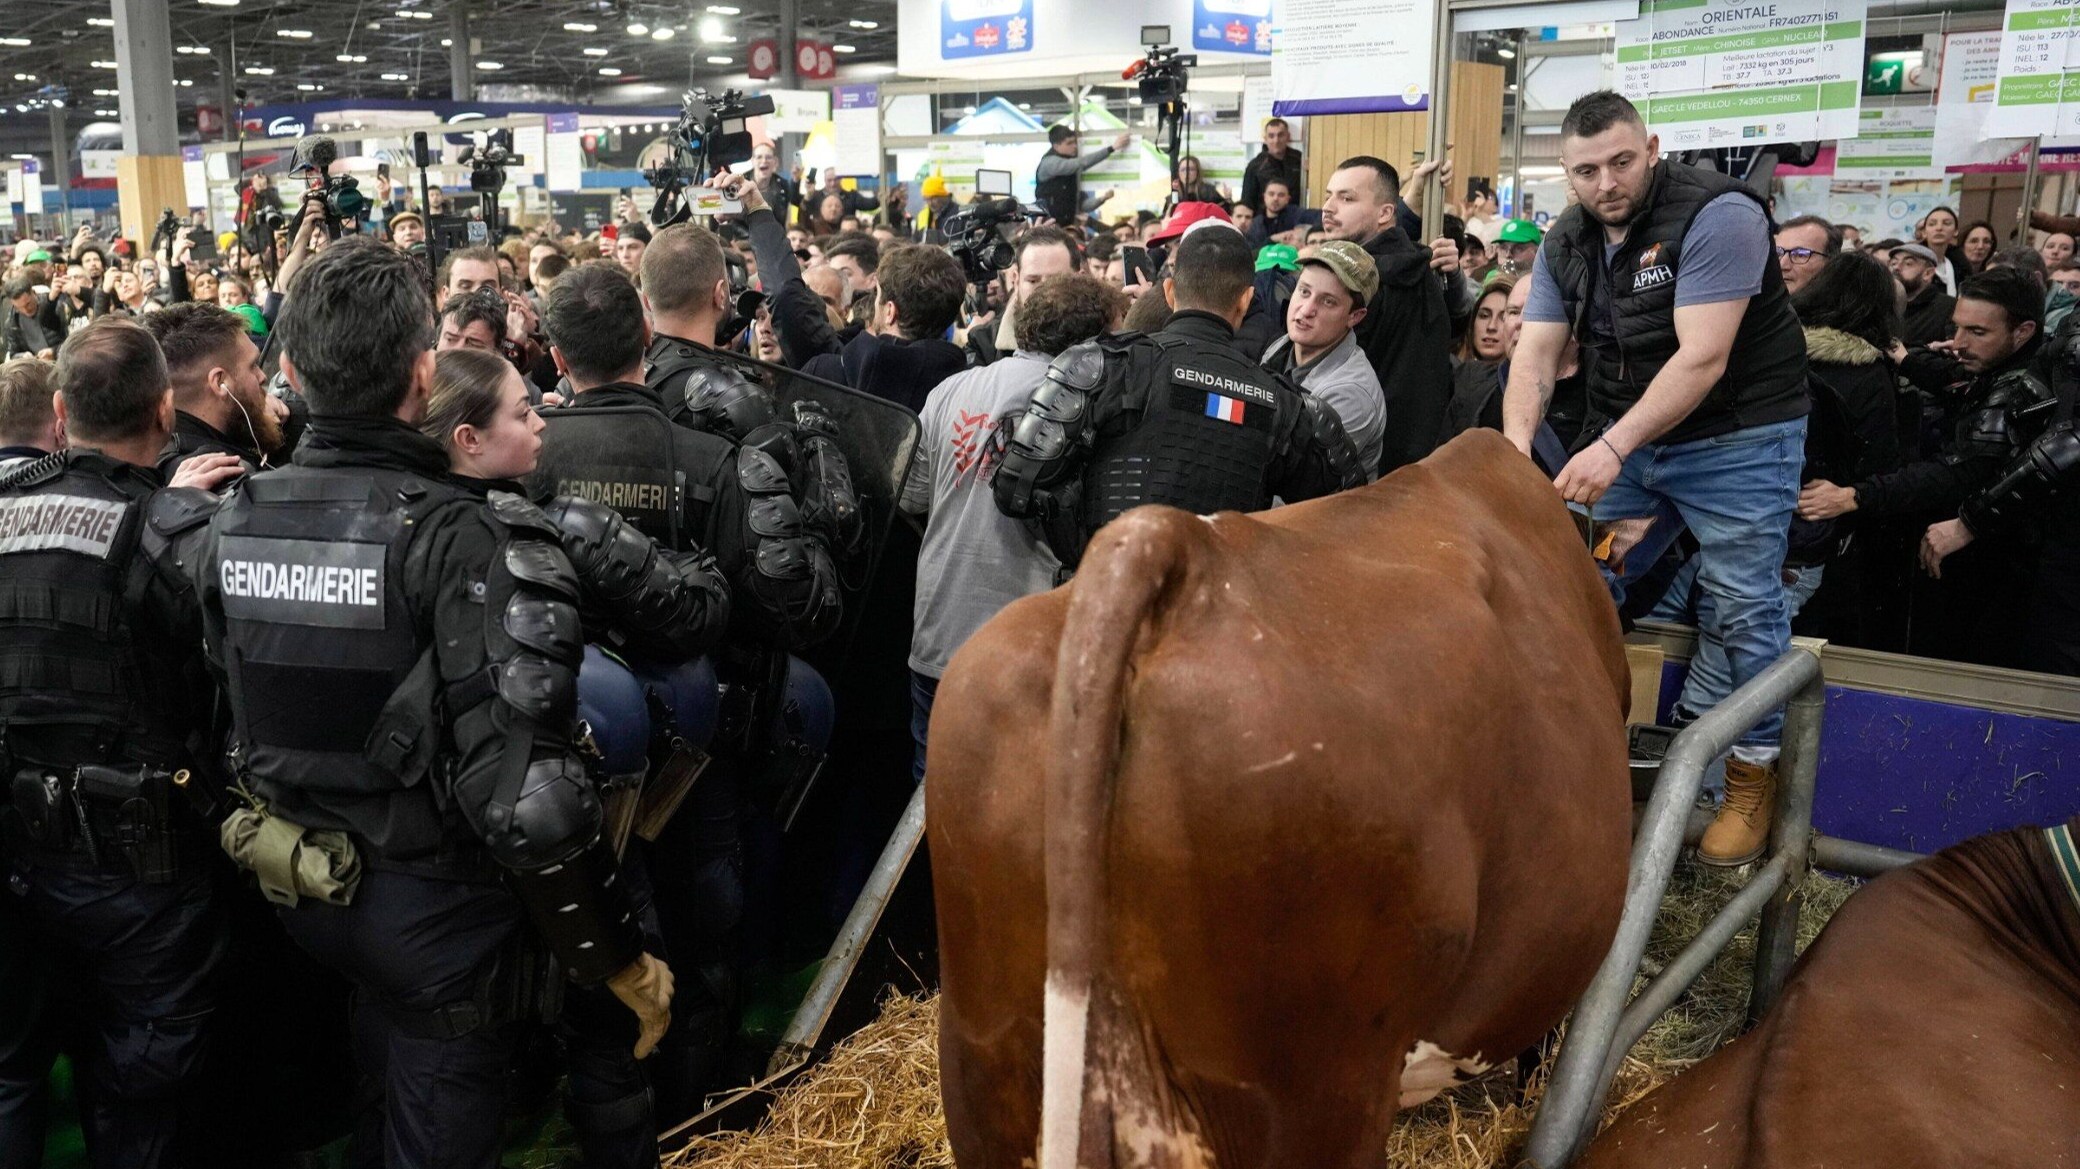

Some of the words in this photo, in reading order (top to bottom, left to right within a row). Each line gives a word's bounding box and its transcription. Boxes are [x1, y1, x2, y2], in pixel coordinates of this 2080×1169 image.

[1702, 5, 1776, 24] ORIENTALE
[1652, 26, 1714, 40] ABONDANCE
[1661, 45, 1688, 56] JETSET
[1714, 38, 1756, 50] CHINOISE
[1756, 50, 1786, 58] lactation
[1799, 47, 1816, 56] sujet
[1650, 60, 1686, 70] 10/02/2018
[1758, 61, 1768, 69] kg
[1795, 57, 1814, 66] jours
[1736, 72, 1751, 80] 37.7
[2048, 78, 2078, 88] GAEC
[1652, 104, 1675, 114] GAEC
[1676, 102, 1686, 112] LE
[1738, 97, 1764, 106] 74350
[1766, 94, 1802, 103] CERNEX
[1634, 266, 1673, 288] APMH
[1174, 368, 1274, 403] GENDARMERIE
[222, 560, 377, 606] GENDARMERIE
